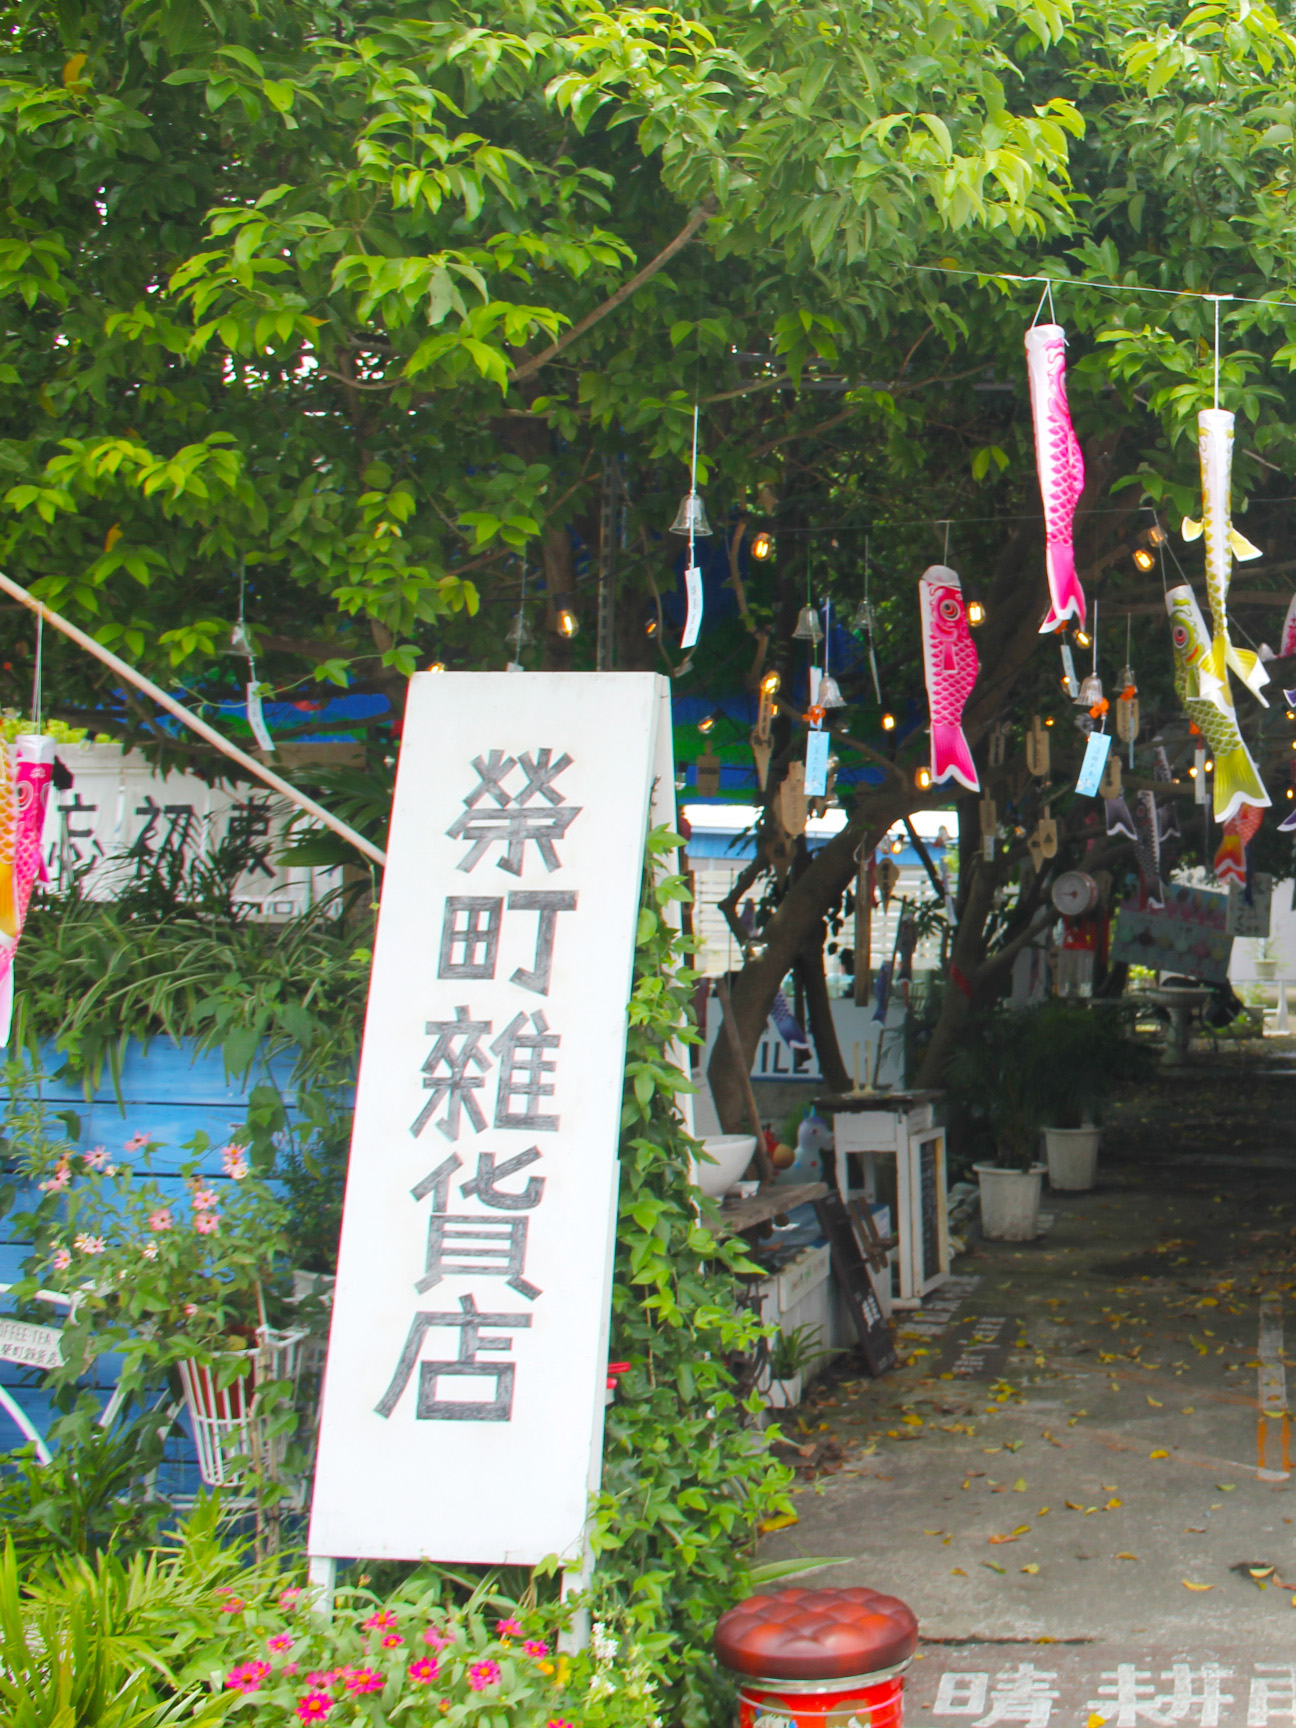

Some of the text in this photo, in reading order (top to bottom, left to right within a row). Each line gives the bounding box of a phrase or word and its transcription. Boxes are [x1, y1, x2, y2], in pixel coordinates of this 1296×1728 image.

[375, 747, 584, 1420] 榮町雜貨店
